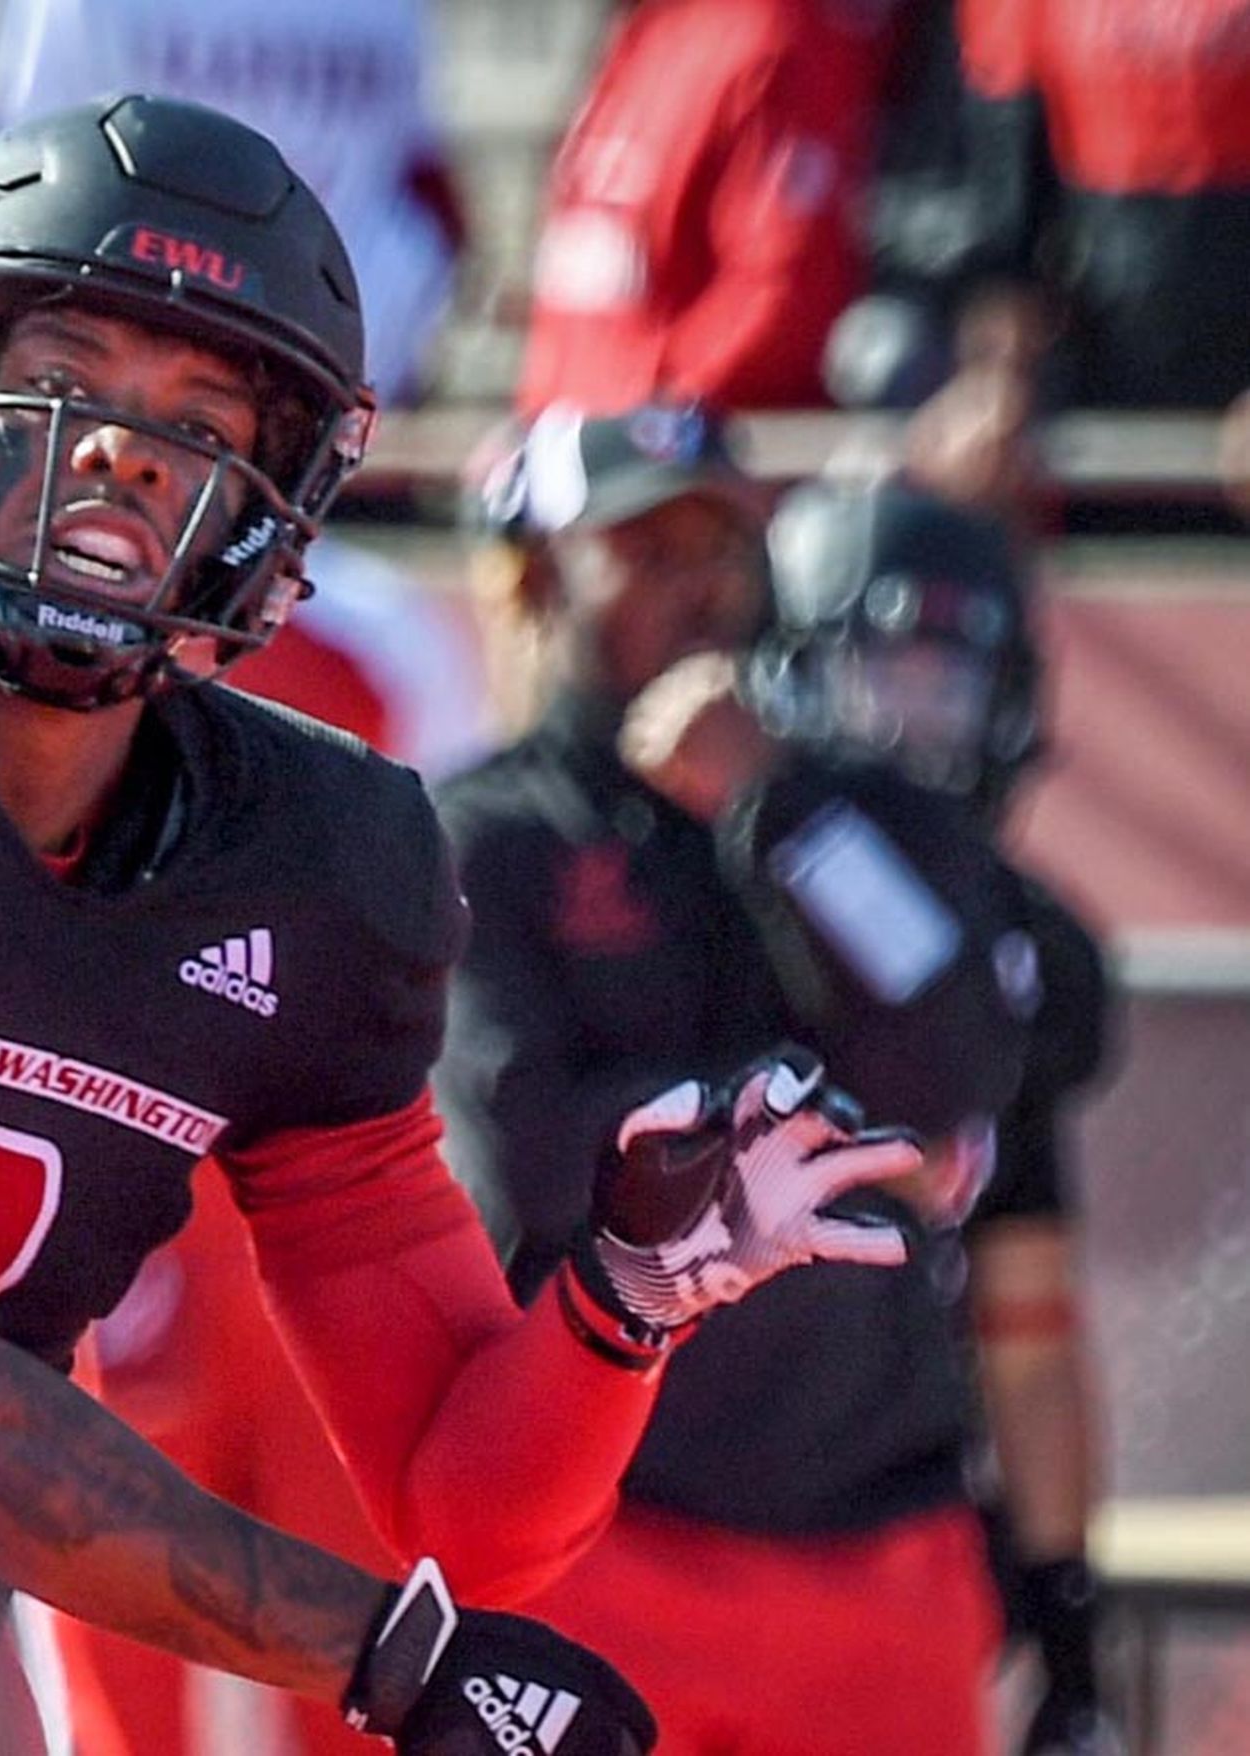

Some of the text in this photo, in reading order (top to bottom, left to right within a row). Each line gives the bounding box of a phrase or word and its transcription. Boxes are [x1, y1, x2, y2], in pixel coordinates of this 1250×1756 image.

[132, 226, 246, 291] EWU
[38, 604, 124, 644] Riddell
[179, 959, 279, 1017] adidas
[463, 1676, 535, 1756] adid
